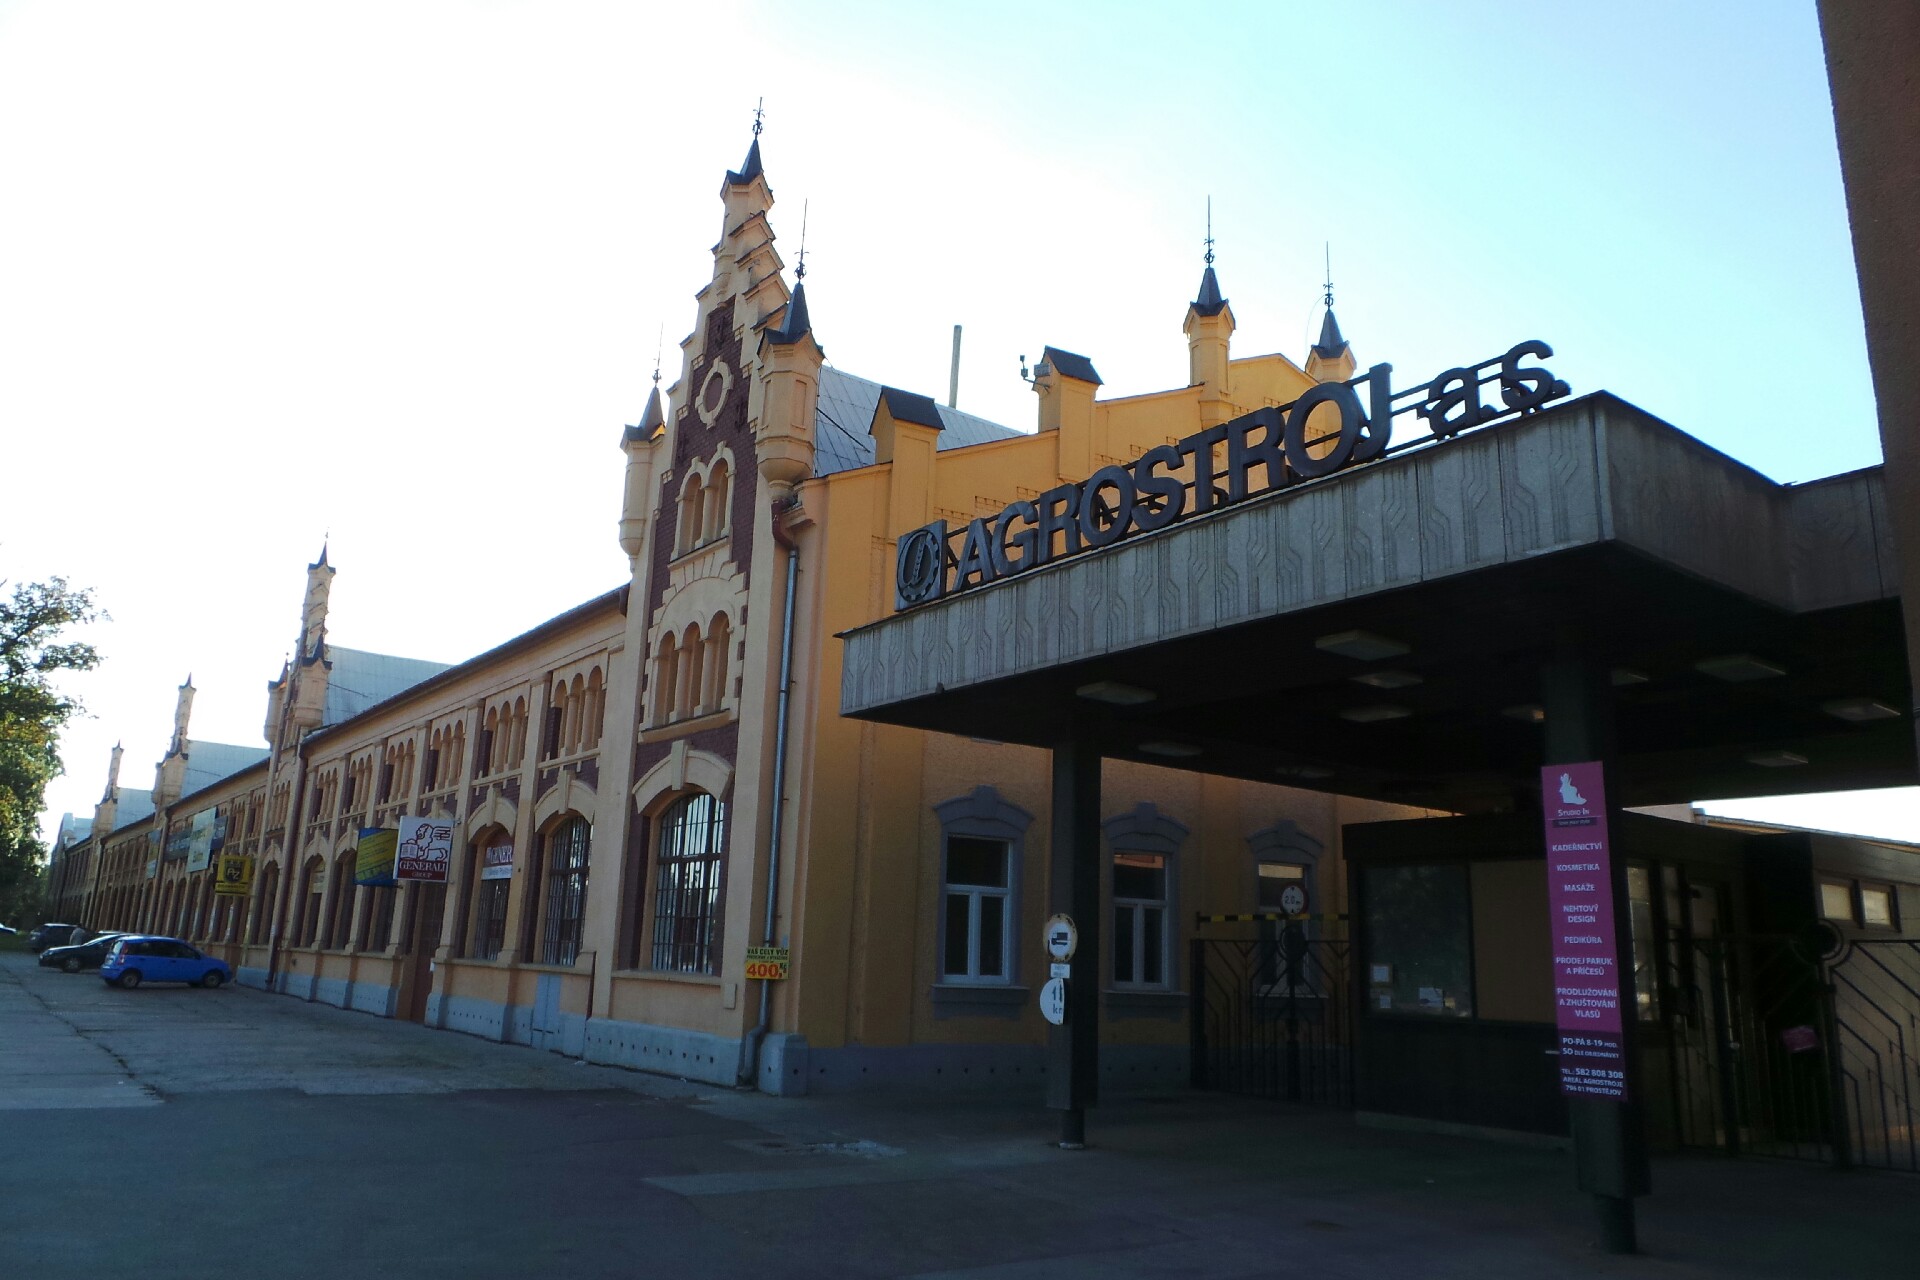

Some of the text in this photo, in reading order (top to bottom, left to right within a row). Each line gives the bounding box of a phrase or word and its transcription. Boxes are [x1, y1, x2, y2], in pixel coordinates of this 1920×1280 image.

[953, 362, 1393, 591] AGROSTROJ
[1552, 842, 1602, 852] KADEŘNICTVÍ
[399, 861, 446, 872] GENERALI
[1556, 863, 1600, 872] KOSMETIKA
[1564, 882, 1596, 892] MASÁŽE
[1563, 904, 1599, 913] NEHTOVÝ
[1568, 915, 1596, 923] DESIGN
[1564, 935, 1603, 944] PEDIKÚRA
[1556, 957, 1613, 965] PRODEJ PARUK
[1573, 966, 1605, 976] PŘÍČESŮ
[1556, 987, 1617, 997] PRODLUŽOVÁNÍ
[1559, 998, 1565, 1006] A
[1575, 1009, 1601, 1018] VLASŮ
[1586, 1039, 1603, 1047] 8-19
[1562, 1047, 1573, 1055] SO
[1575, 1068, 1590, 1076] 582
[1591, 1069, 1606, 1077] 808
